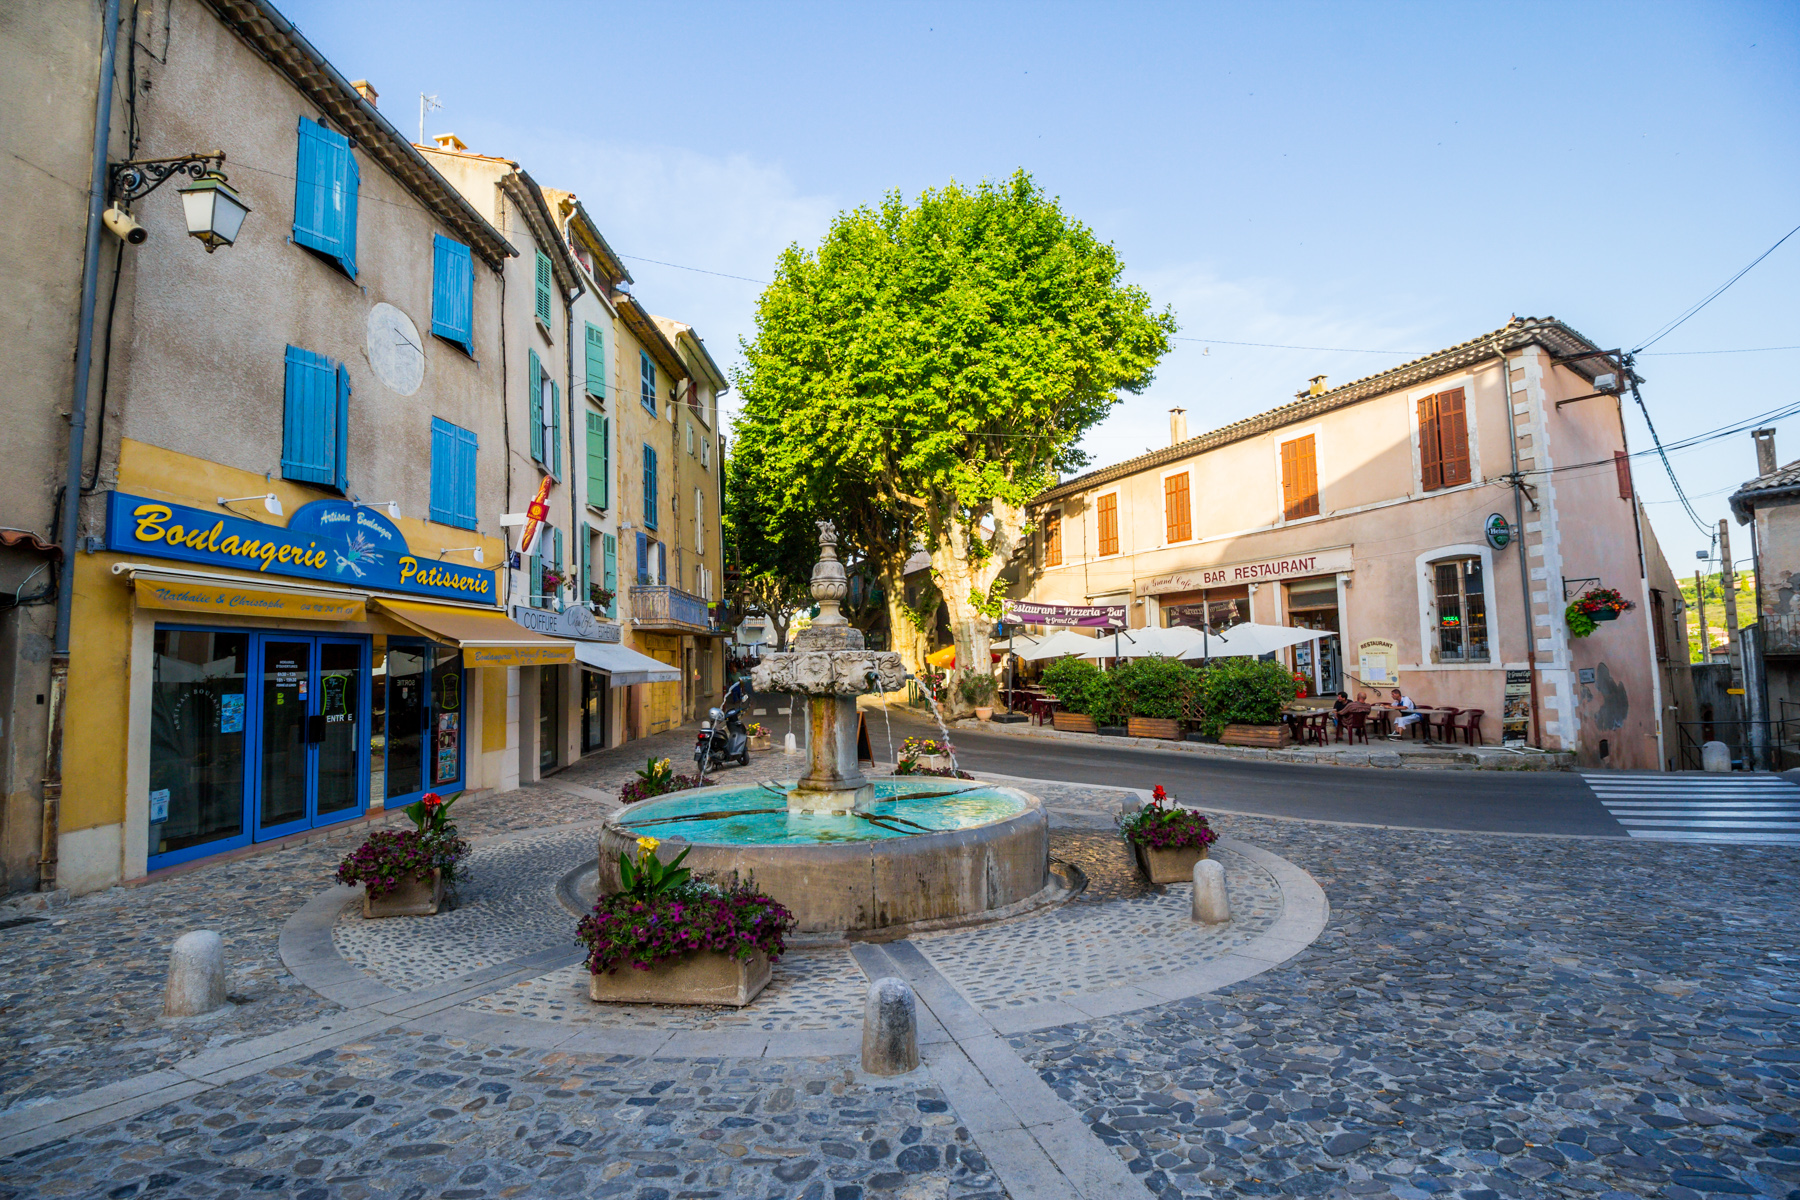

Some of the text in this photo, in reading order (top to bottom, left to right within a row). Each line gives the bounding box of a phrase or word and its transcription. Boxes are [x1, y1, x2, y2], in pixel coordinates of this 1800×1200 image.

[320, 510, 393, 541] Artisan Boulanger
[133, 504, 328, 571] Boulangerie
[398, 556, 489, 594] Patisserie
[1203, 556, 1317, 584] BAR RESTAURANT
[1150, 576, 1173, 590] Grand
[155, 588, 211, 604] Nathalie
[215, 593, 225, 604] &
[228, 594, 285, 611] Christophe
[301, 603, 311, 611] 04
[523, 611, 558, 632] COIFFURE
[1051, 616, 1067, 625] Grand
[1063, 606, 1101, 617] Pizzeria
[1106, 606, 1125, 617] Bar
[1360, 640, 1394, 649] RESTAURANT
[174, 688, 220, 730] ARTISAN BOULANGER
